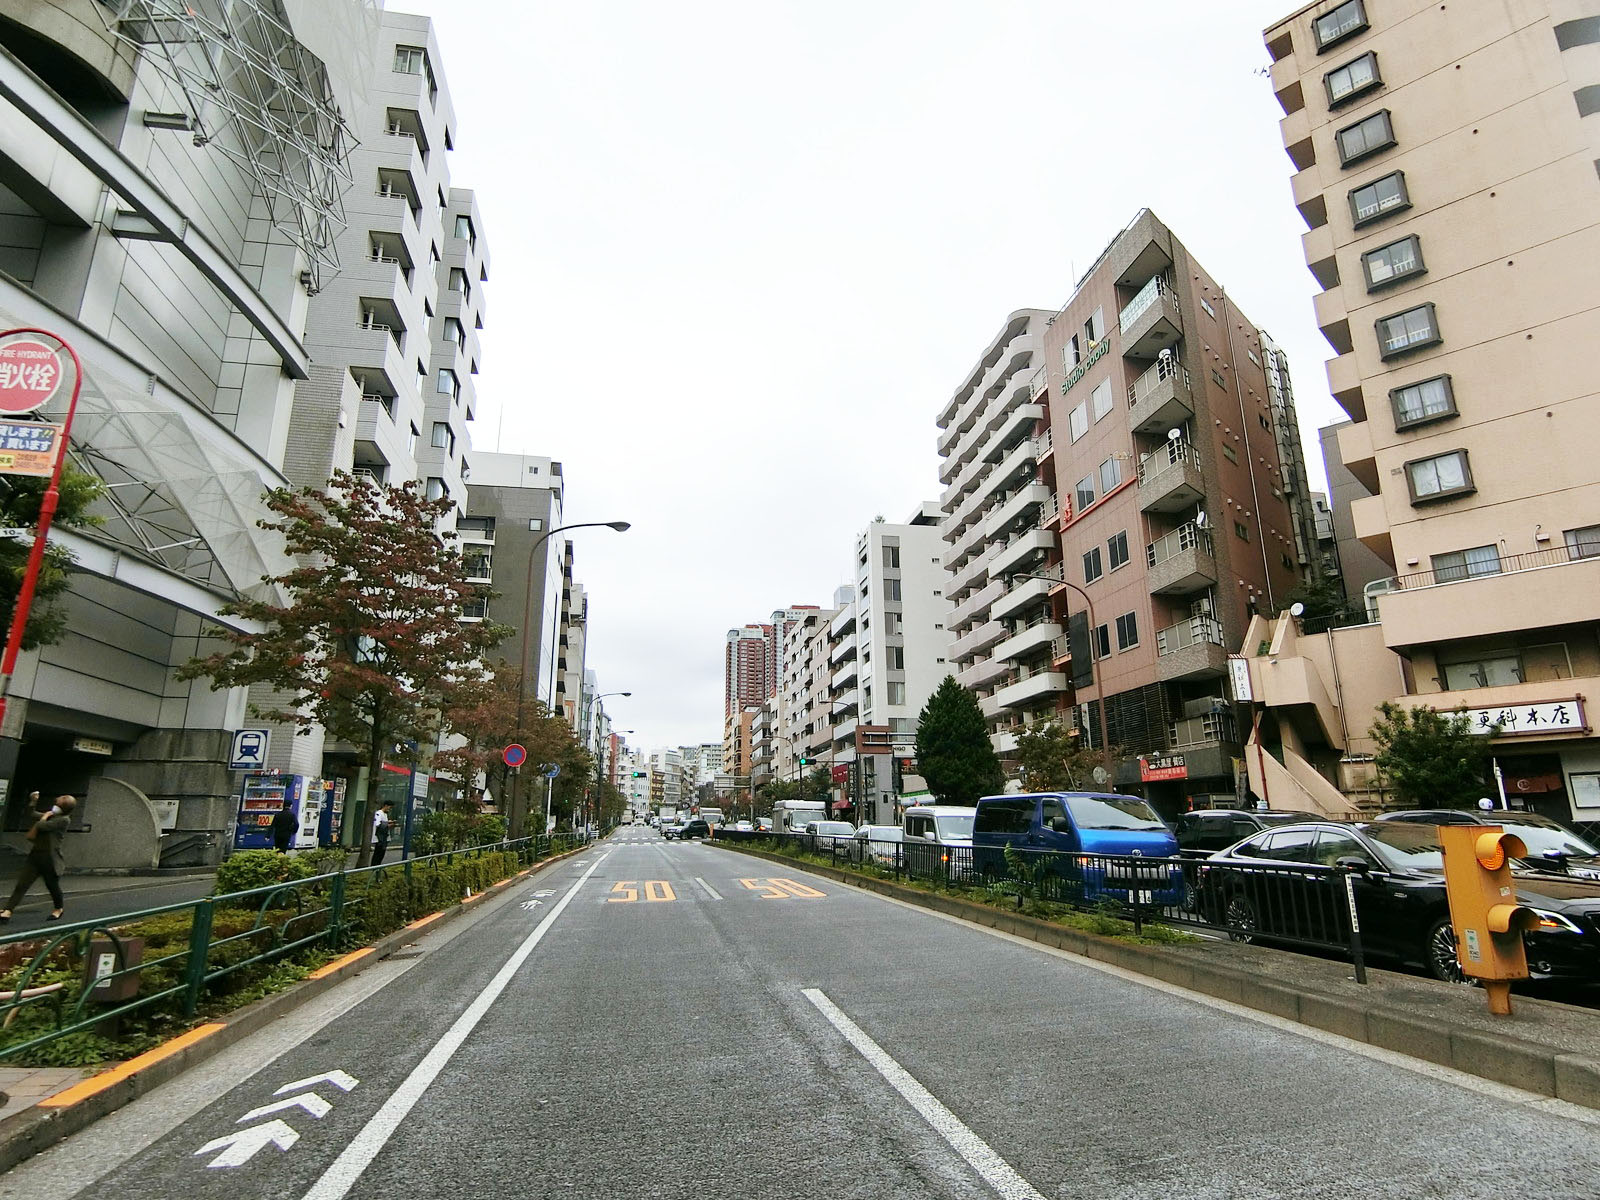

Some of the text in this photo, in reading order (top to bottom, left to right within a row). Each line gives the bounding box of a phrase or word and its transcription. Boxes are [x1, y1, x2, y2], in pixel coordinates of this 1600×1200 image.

[0, 349, 52, 360] FIRE HYDRANT
[1061, 367, 1085, 395] Studio
[1475, 705, 1571, 730] 更科本店
[607, 880, 677, 902] 50
[738, 878, 828, 899] 50
